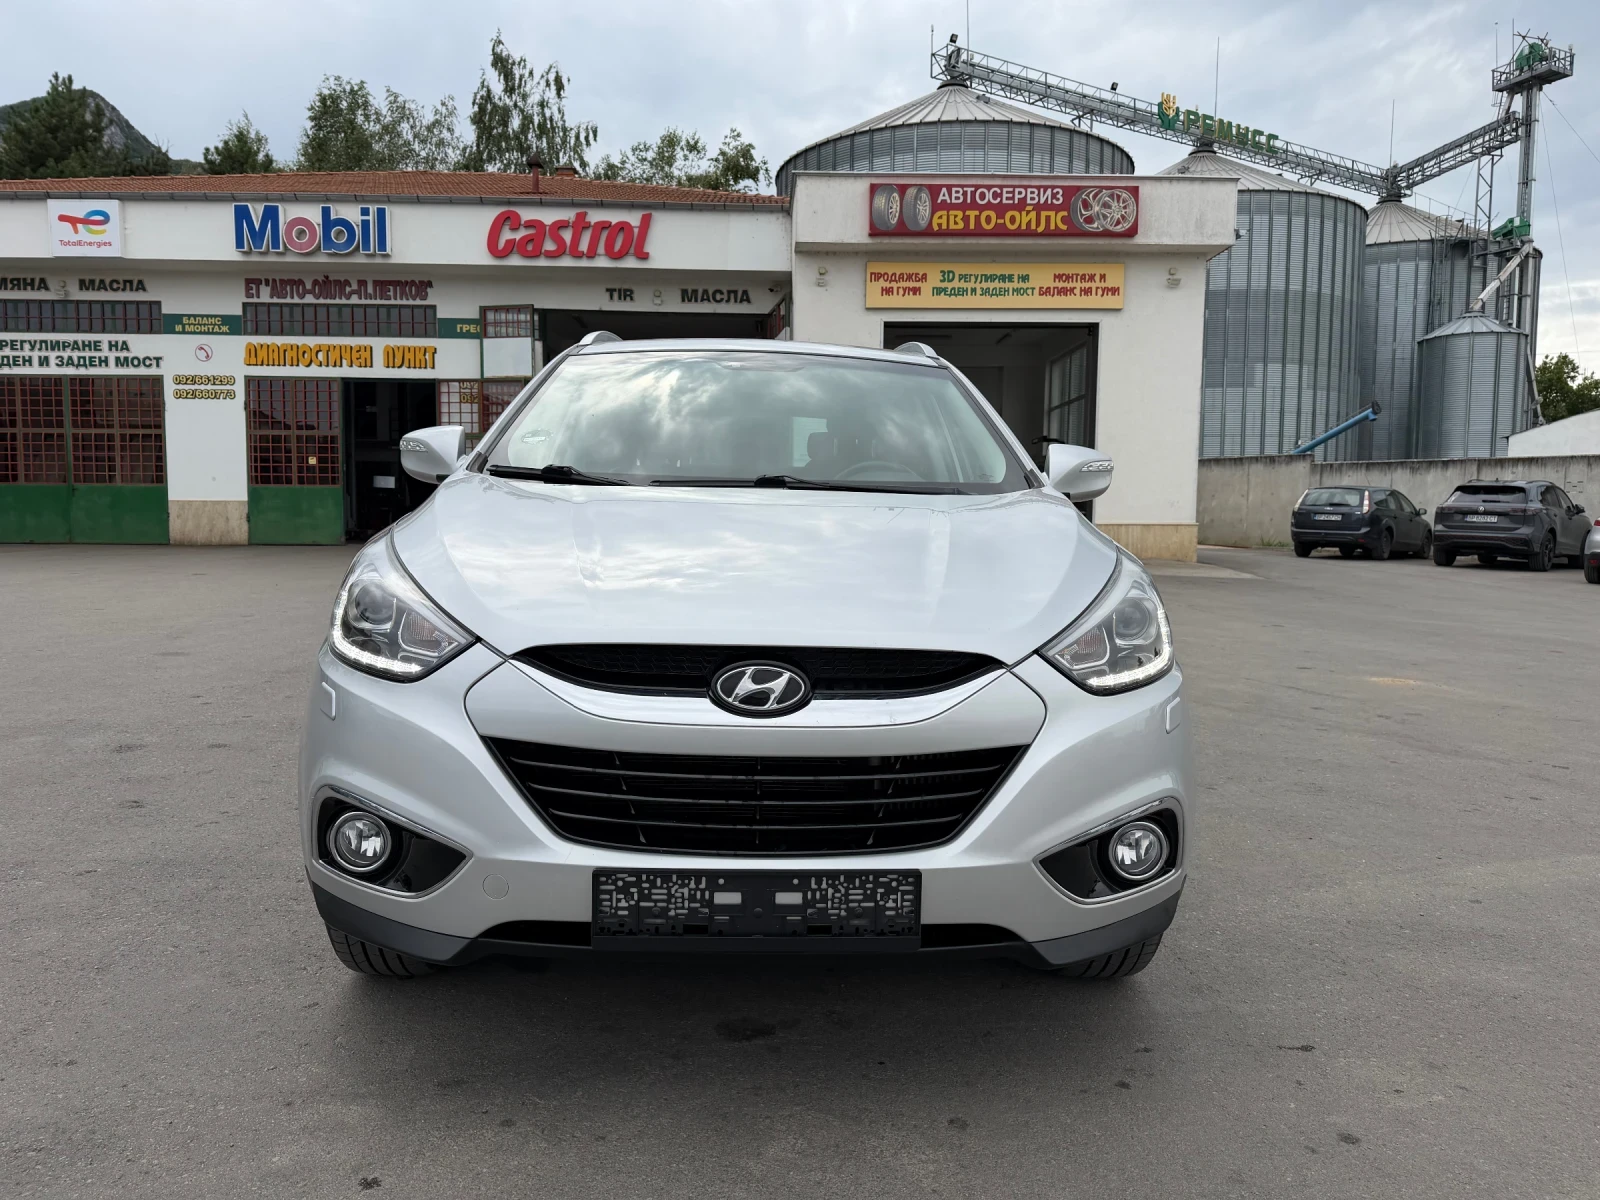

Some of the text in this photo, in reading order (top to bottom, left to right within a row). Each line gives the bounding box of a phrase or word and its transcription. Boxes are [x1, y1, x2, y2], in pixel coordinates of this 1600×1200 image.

[1183, 109, 1279, 155] РЕМУСС
[937, 187, 1064, 205] АВТОСЕРВИЗ
[932, 205, 1068, 233] АВТО-ОЙЛС
[232, 203, 390, 255] Mobil
[487, 209, 653, 260] Castrol
[58, 240, 112, 249] TotalEnergies
[869, 272, 928, 284] ПРОДАЖБА
[939, 270, 1030, 284] 3D РЕГУЛИРАНЕ НА
[1053, 273, 1106, 284] МОНТАЖ И
[78, 278, 148, 293] МАСЛА
[881, 286, 922, 297] НА ГУМИ
[1038, 286, 1120, 297] БАЛАНС НА ГУМИ
[605, 287, 635, 302] TIR
[680, 288, 752, 304] МАСЛА
[932, 287, 1036, 298] ПРЕДЕН И ЗАДЕН МОСТ
[183, 316, 222, 325] БАЛАНС
[175, 324, 230, 333] И МОНТАЖ
[0, 339, 132, 352] РЕГУЛИРАНЕ НА
[244, 342, 437, 369] ДИАГНОСТИЧЕН ПУНКТ
[38, 355, 50, 368] И
[54, 355, 109, 370] ЗАДЕН
[114, 356, 163, 369] МОСТ
[172, 374, 236, 386] 092/661299
[172, 388, 236, 400] 092/660773
